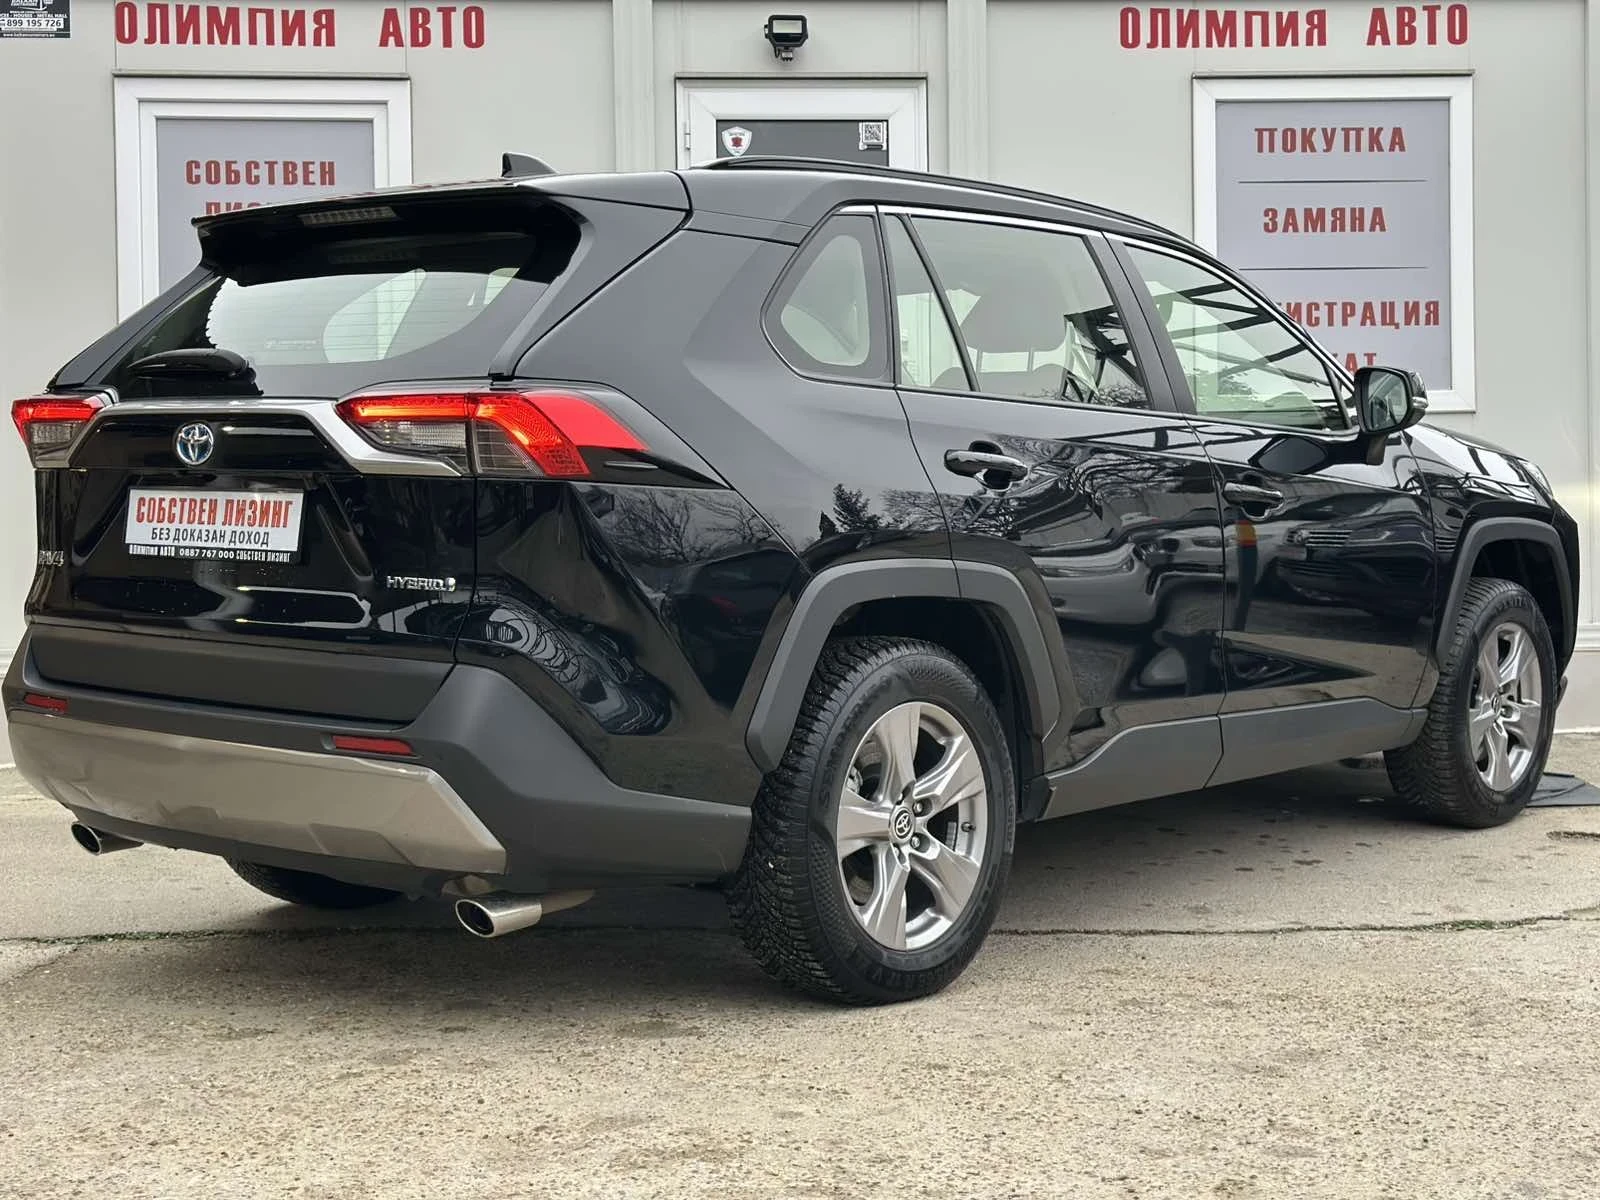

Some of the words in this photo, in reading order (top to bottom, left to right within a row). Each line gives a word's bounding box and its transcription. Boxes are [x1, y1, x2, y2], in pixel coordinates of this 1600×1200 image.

[6, 19, 24, 27] 899
[26, 19, 42, 27] 195
[45, 19, 62, 27] 726
[115, 2, 336, 48] ОЛИМПИЯ
[379, 5, 486, 49] АВТО
[1119, 6, 1328, 50] ОЛИМПИЯ
[1366, 3, 1469, 47] АВТО
[1255, 127, 1406, 153] ПОКУПКА
[186, 160, 336, 186] СОБСТВЕН
[1263, 207, 1387, 234] ЗАМЯНА
[1280, 301, 1440, 329] ИСТРАЦИЯ
[1332, 352, 1377, 374] АТ
[136, 496, 218, 525] СОБСТВЕН
[222, 499, 293, 528] ЛИЗИНГ
[151, 527, 171, 541] БЕЗ
[173, 528, 226, 544] ДОКАЗАН
[228, 531, 270, 548] ДОХОД
[179, 548, 200, 557] 0887
[201, 549, 217, 558] 767
[218, 550, 235, 559] 000
[386, 575, 446, 591] HYBRID
